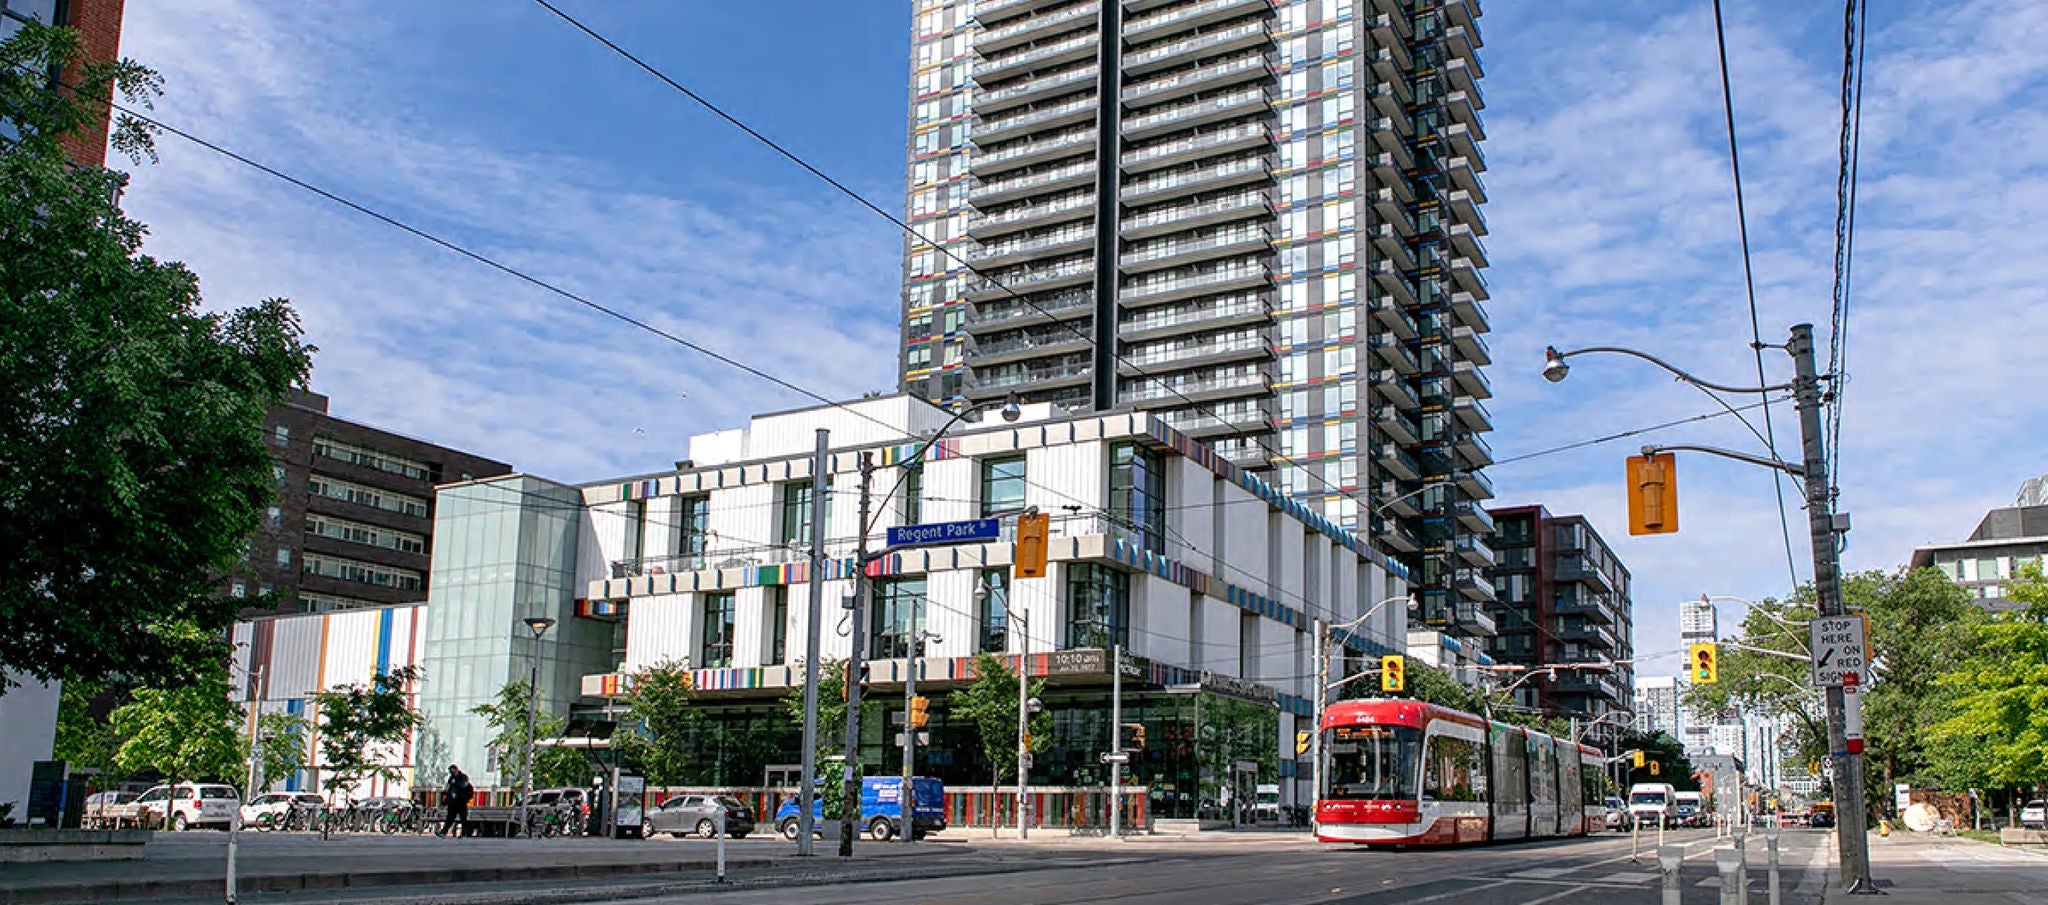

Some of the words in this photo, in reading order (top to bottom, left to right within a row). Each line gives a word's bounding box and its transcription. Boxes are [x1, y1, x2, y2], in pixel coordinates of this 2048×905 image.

[897, 526, 942, 544] Regent
[947, 523, 976, 536] Park
[1822, 620, 1851, 632] STOP
[1821, 633, 1853, 644] HERE
[1844, 645, 1861, 655] ON
[1056, 653, 1082, 665] 10:10
[1837, 657, 1861, 668] RED
